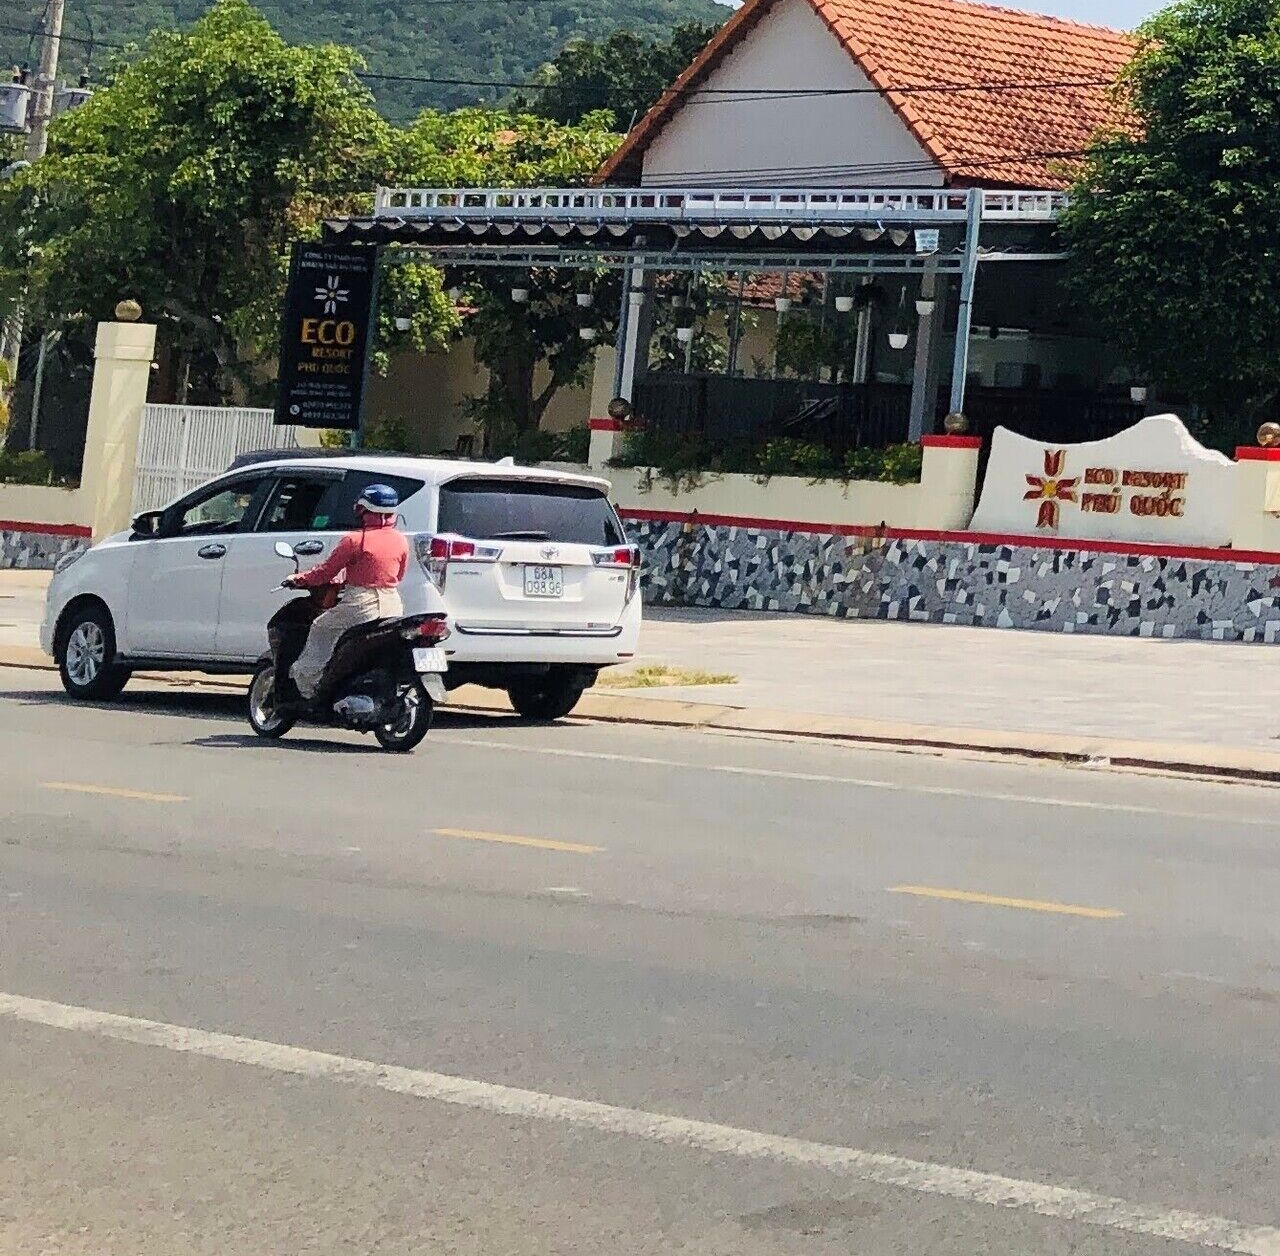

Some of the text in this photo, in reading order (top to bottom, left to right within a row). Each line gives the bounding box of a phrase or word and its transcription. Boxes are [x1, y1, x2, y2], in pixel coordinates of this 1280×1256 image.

[300, 317, 356, 346] ECO
[311, 347, 354, 359] RESORT
[1084, 467, 1188, 489] ECO RESORT
[1081, 487, 1186, 518] PHÚ QUỐC
[534, 566, 554, 581] 68A
